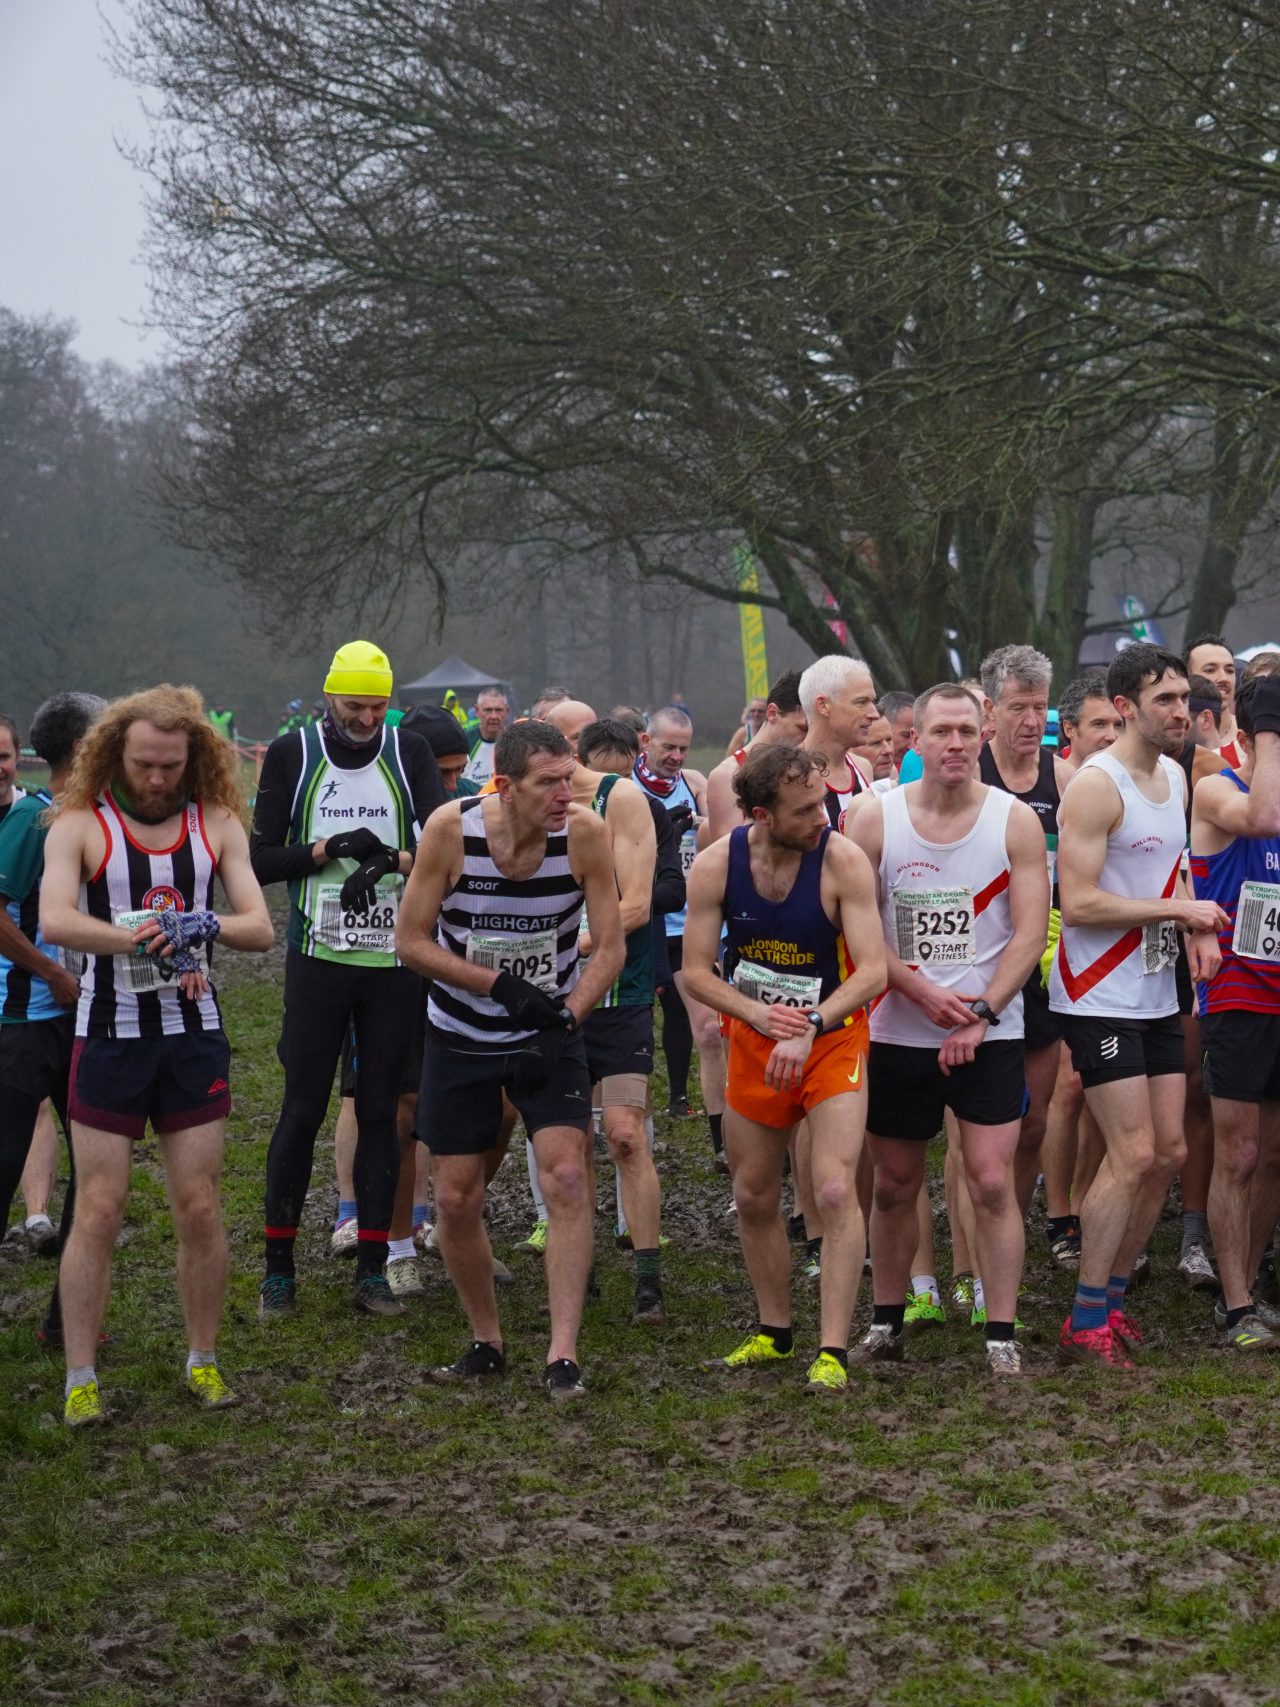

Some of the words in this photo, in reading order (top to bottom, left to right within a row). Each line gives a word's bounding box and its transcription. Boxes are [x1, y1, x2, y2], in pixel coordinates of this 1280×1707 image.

[595, 794, 605, 813] oar
[1029, 801, 1052, 809] HARROW
[320, 807, 354, 818] Trent
[358, 806, 389, 818] Park
[189, 810, 197, 834] soar
[896, 862, 940, 874] HILLINGDON
[468, 880, 499, 891] soar
[344, 905, 395, 930] 6368
[471, 914, 560, 931] HIGHGATE
[917, 910, 970, 937] 5252
[360, 933, 390, 942] START
[471, 936, 529, 948] METROPOLITAN
[357, 940, 389, 949] FITNESS
[479, 944, 515, 953] COUNTRY
[517, 943, 546, 953] LEAGUE
[752, 938, 798, 954] LONDON
[934, 943, 968, 954] START
[737, 945, 816, 966] HEATHSIDE
[933, 952, 967, 961] FITNESS
[499, 952, 552, 979] 5095
[741, 963, 790, 983] METROPOLITAN
